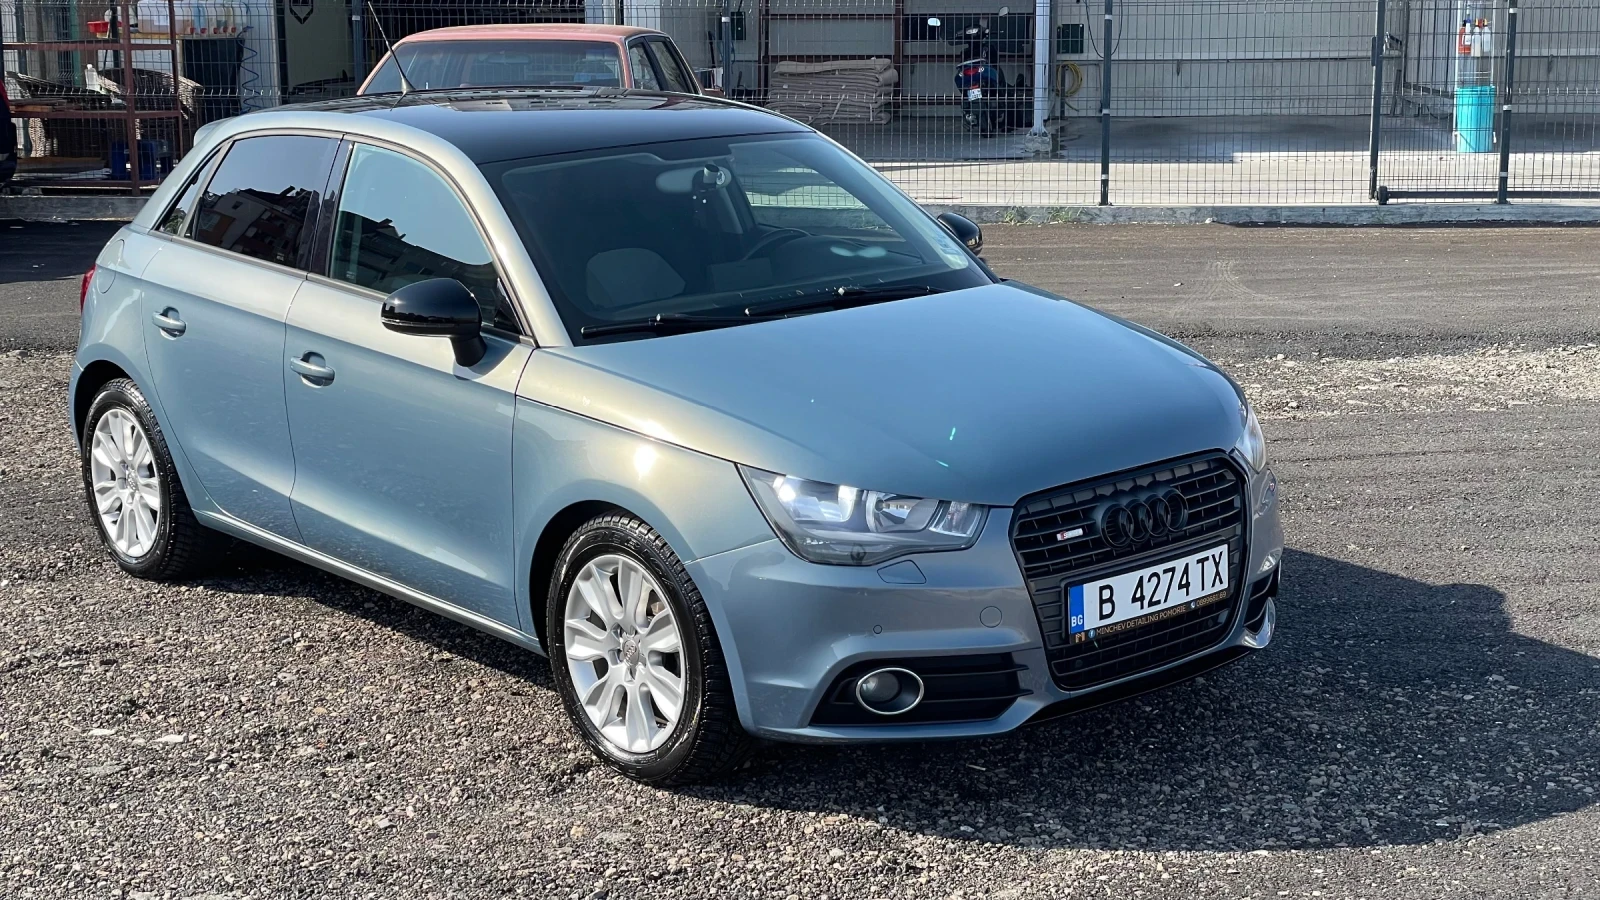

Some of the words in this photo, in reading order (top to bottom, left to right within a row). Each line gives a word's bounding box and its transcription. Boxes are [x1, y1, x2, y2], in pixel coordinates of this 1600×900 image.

[1099, 584, 1115, 621] B
[1131, 562, 1191, 610] 4274
[1196, 551, 1224, 591] TX
[1071, 614, 1083, 628] BG
[1096, 619, 1127, 635] MINCHEV
[1126, 612, 1159, 629] DETAILING
[1159, 605, 1186, 621] POMORIE
